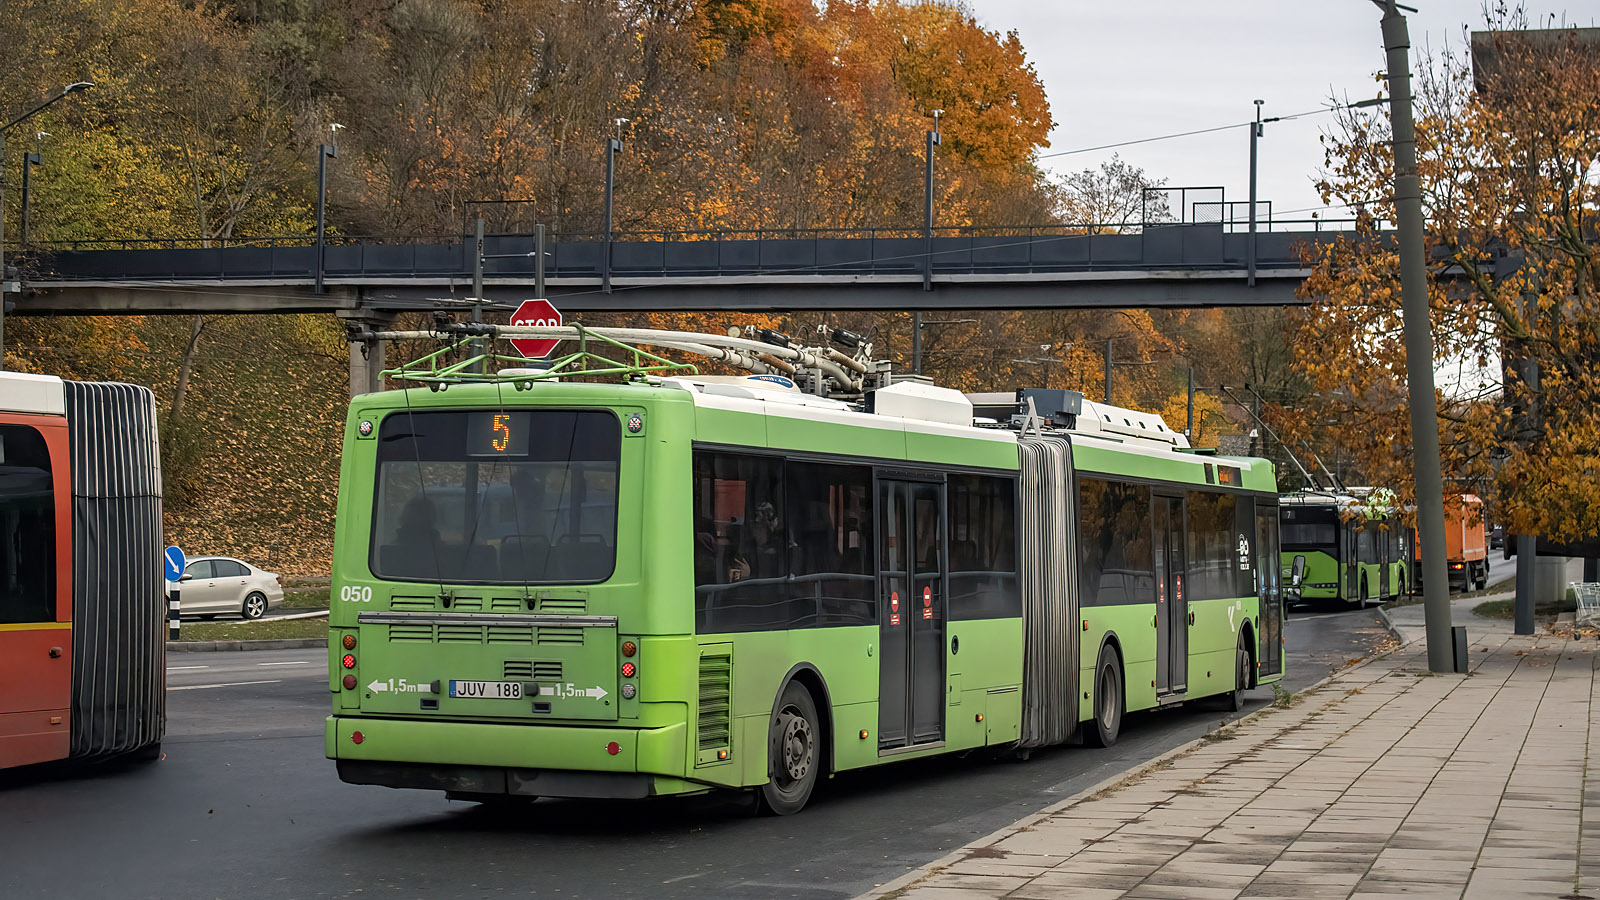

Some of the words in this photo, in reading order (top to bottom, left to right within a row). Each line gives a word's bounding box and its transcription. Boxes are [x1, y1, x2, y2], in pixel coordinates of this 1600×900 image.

[493, 414, 510, 451] 5
[341, 586, 372, 602] 050
[388, 678, 417, 695] 1,5m
[457, 682, 486, 697] JUV
[496, 683, 520, 697] 188
[555, 682, 585, 700] 1,5m
